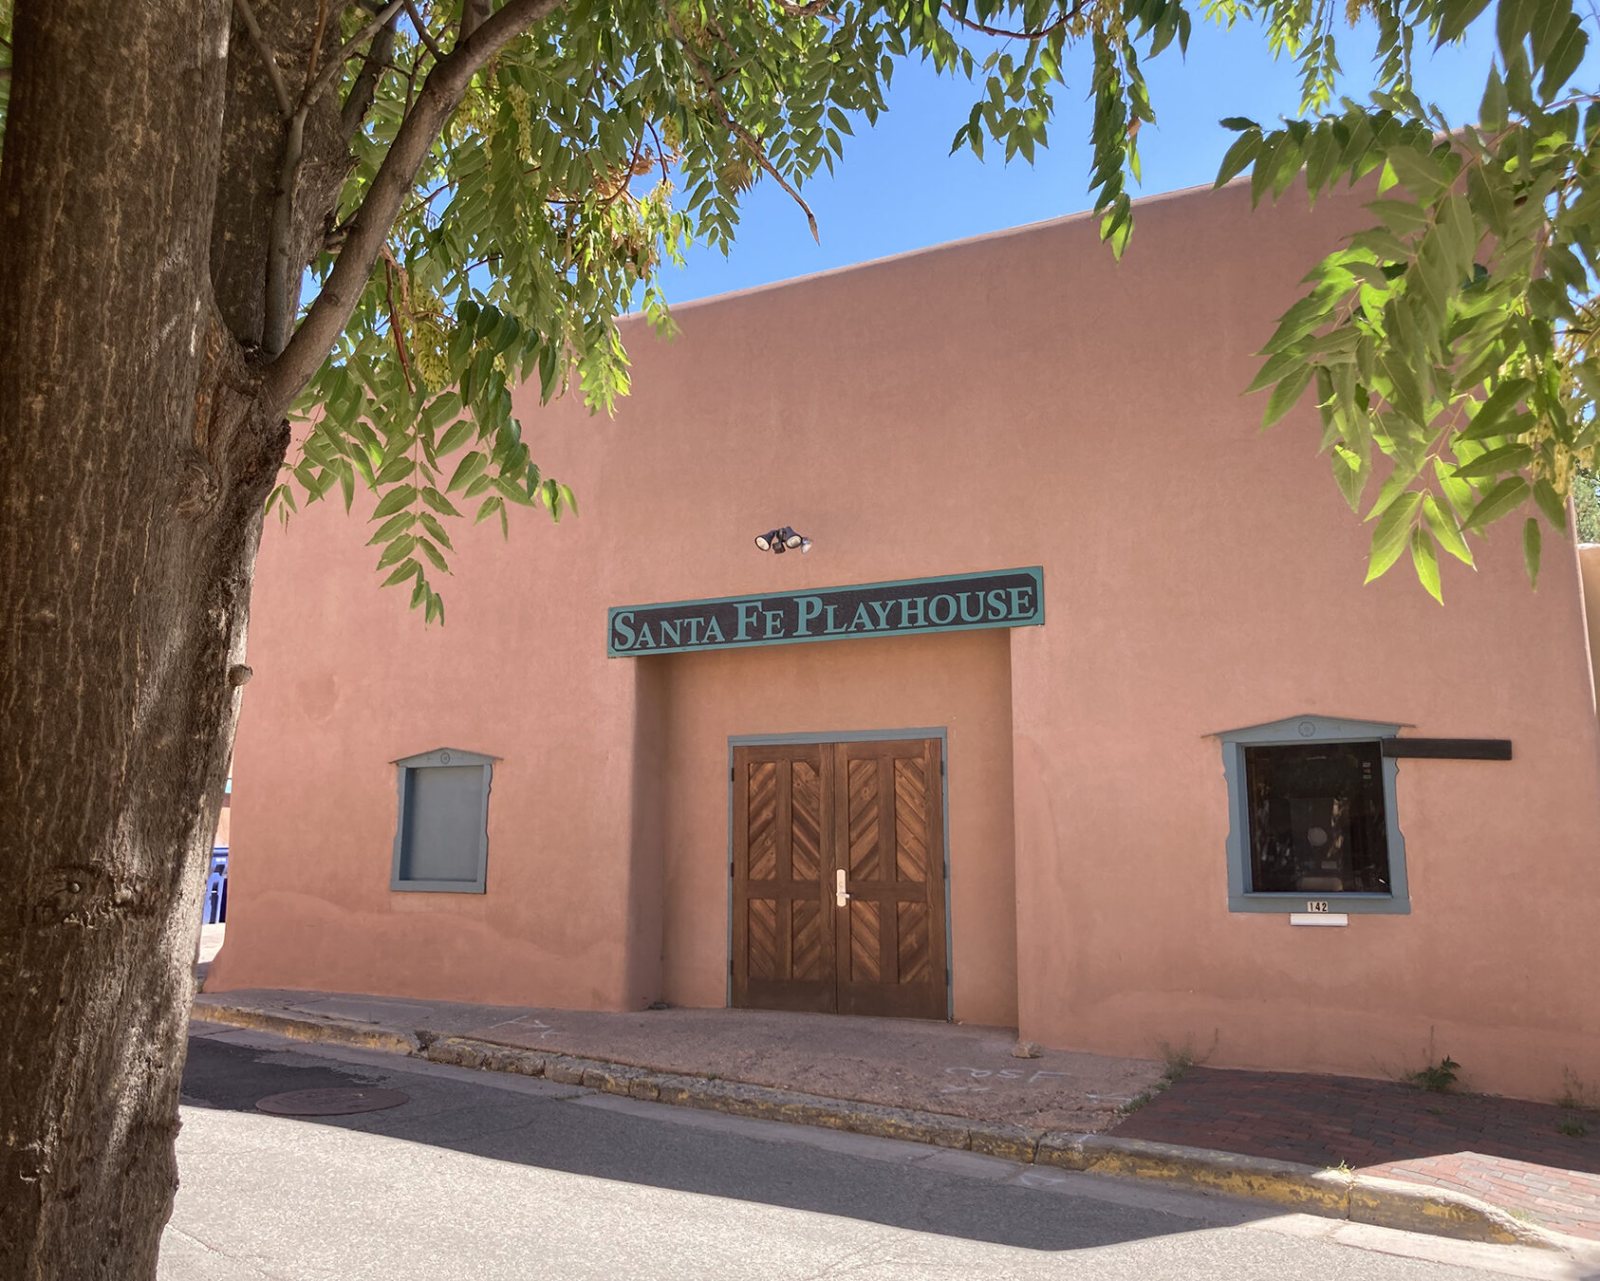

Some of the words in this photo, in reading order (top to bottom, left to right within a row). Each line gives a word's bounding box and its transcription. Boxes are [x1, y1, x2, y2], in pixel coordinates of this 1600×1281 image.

[614, 612, 725, 650] SANTA
[733, 601, 785, 641] FE
[793, 586, 1034, 636] PLAYHOUSE
[1309, 902, 1327, 912] 142
